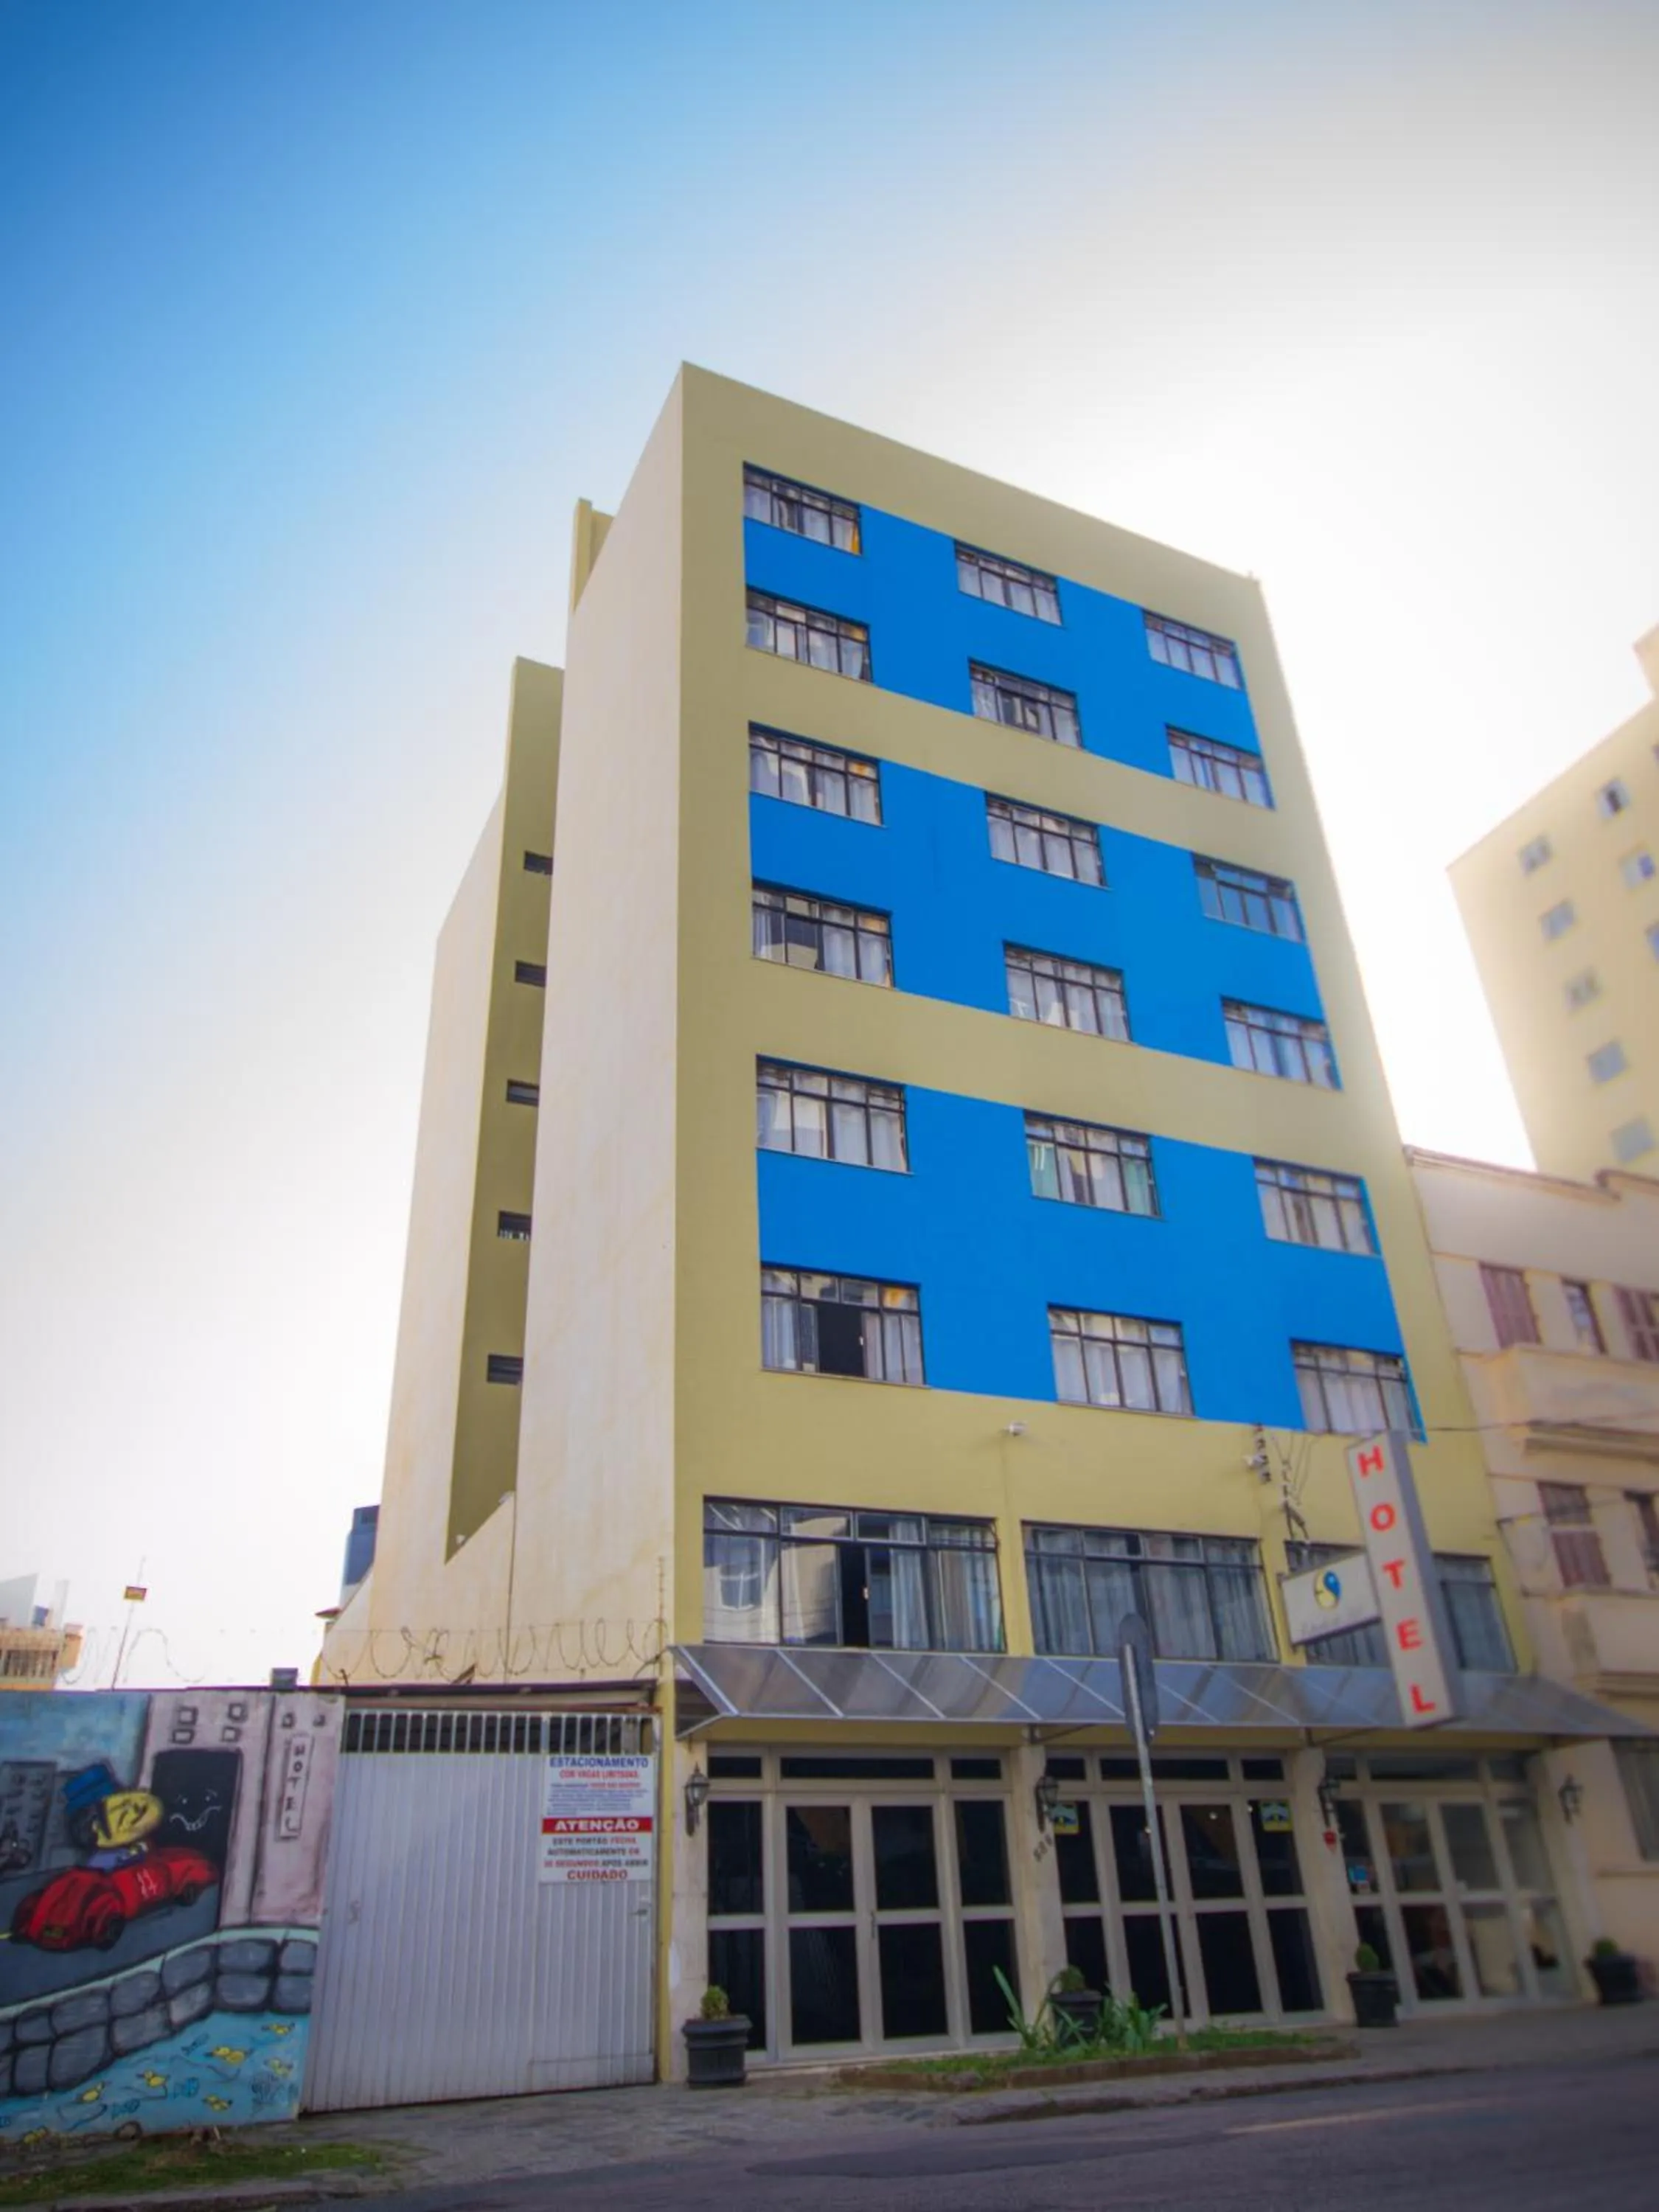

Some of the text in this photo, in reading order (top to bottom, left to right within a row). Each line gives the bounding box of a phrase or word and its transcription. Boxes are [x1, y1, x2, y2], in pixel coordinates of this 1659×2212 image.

[1357, 1446, 1436, 1713] HOTEL
[549, 1757, 649, 1767] ESTACIONAMENTO
[555, 1818, 639, 1832] ATENÇÃO
[567, 1869, 628, 1880] CUIDADO
